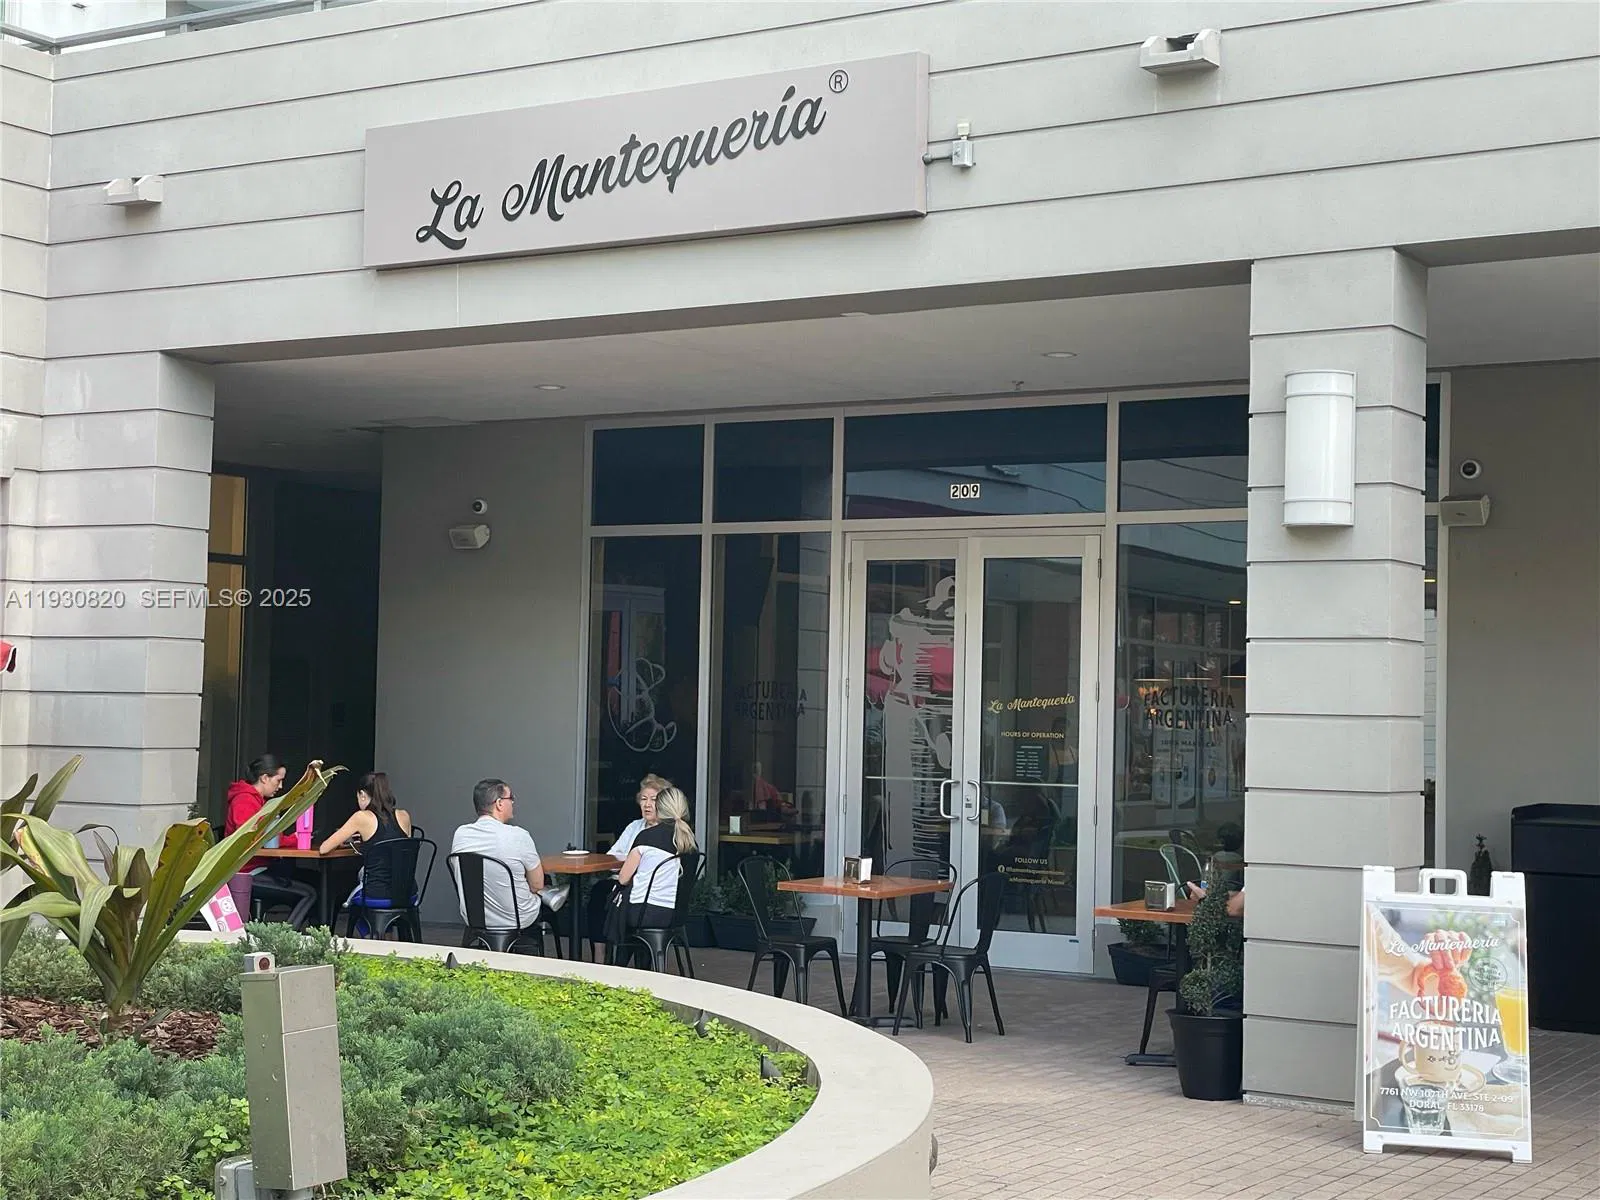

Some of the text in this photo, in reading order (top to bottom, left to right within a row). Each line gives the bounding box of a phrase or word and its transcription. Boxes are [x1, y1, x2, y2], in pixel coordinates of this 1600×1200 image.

[416, 180, 484, 250] La
[500, 85, 827, 221] Mantequería
[950, 484, 980, 498] 209
[1143, 686, 1235, 709] FACTURERIA
[988, 699, 1003, 714] La
[1145, 707, 1232, 730] ARGENTINA
[1031, 732, 1065, 740] OPERATION
[1014, 856, 1039, 864] FOLLOW
[1386, 939, 1405, 957] La
[1389, 995, 1503, 1026] FACTURERIA
[1391, 1022, 1501, 1052] ARGENTINA
[1380, 1087, 1399, 1096] 7761
[1401, 1088, 1418, 1098] NW
[1474, 1094, 1489, 1102] STE
[1447, 1102, 1458, 1111] FL
[1459, 1102, 1484, 1112] 33178
